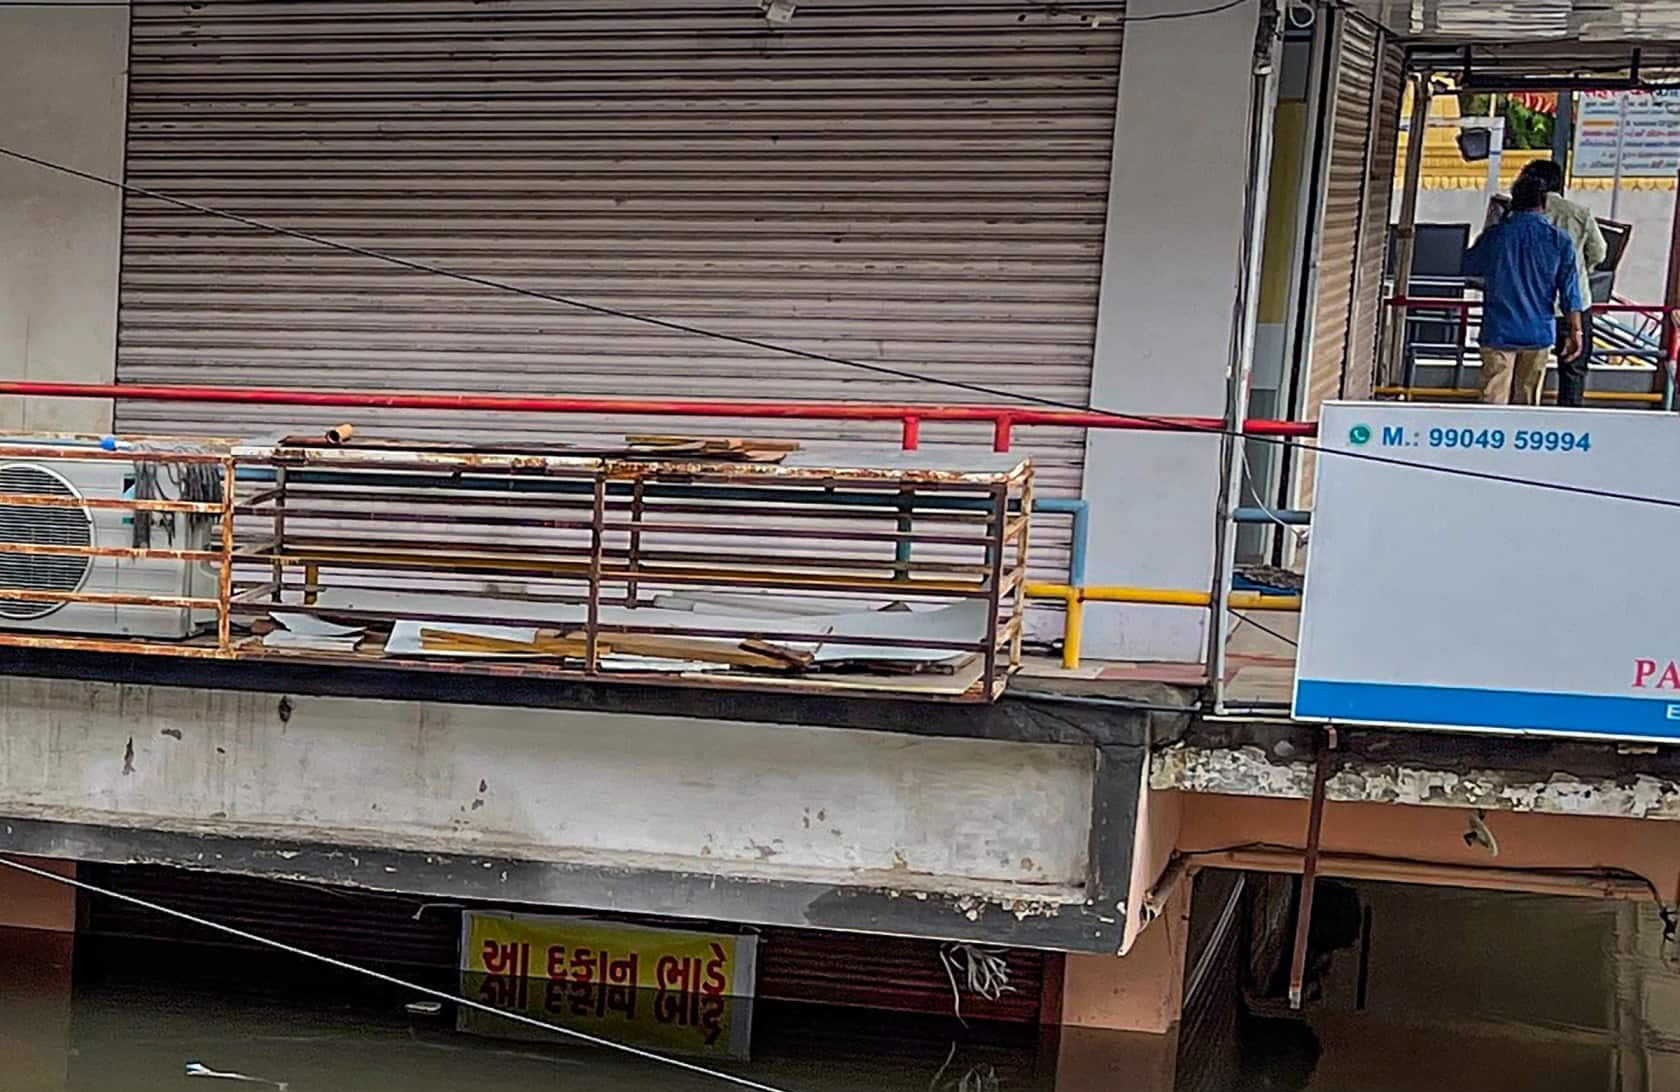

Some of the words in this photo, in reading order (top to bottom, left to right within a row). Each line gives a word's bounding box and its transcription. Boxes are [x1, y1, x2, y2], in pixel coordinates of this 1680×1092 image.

[1429, 428, 1505, 449] 99049
[1514, 430, 1591, 451] 59994
[482, 940, 530, 976] આ
